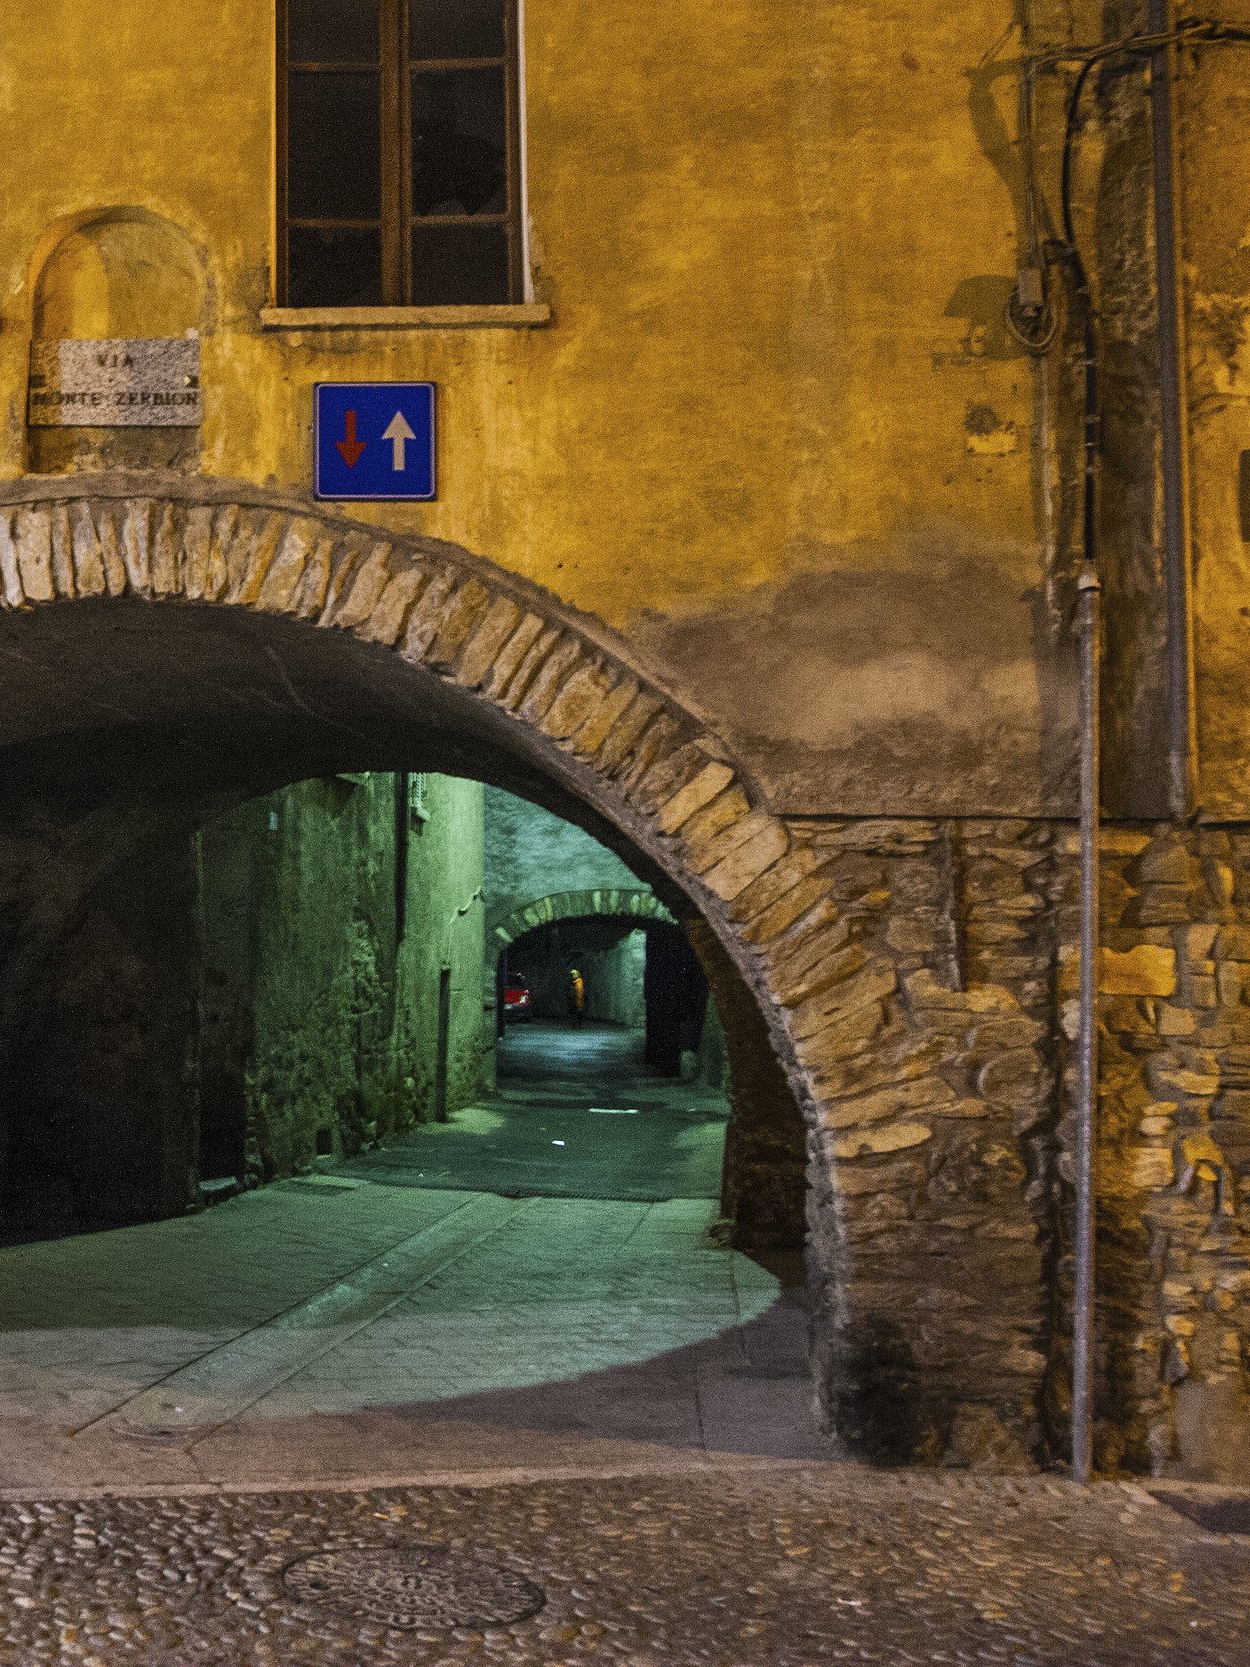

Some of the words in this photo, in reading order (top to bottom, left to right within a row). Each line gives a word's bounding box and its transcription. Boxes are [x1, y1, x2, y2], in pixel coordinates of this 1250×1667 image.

[97, 353, 134, 368] VIA
[32, 391, 101, 406] MONTE
[116, 391, 198, 406] ZERBION
